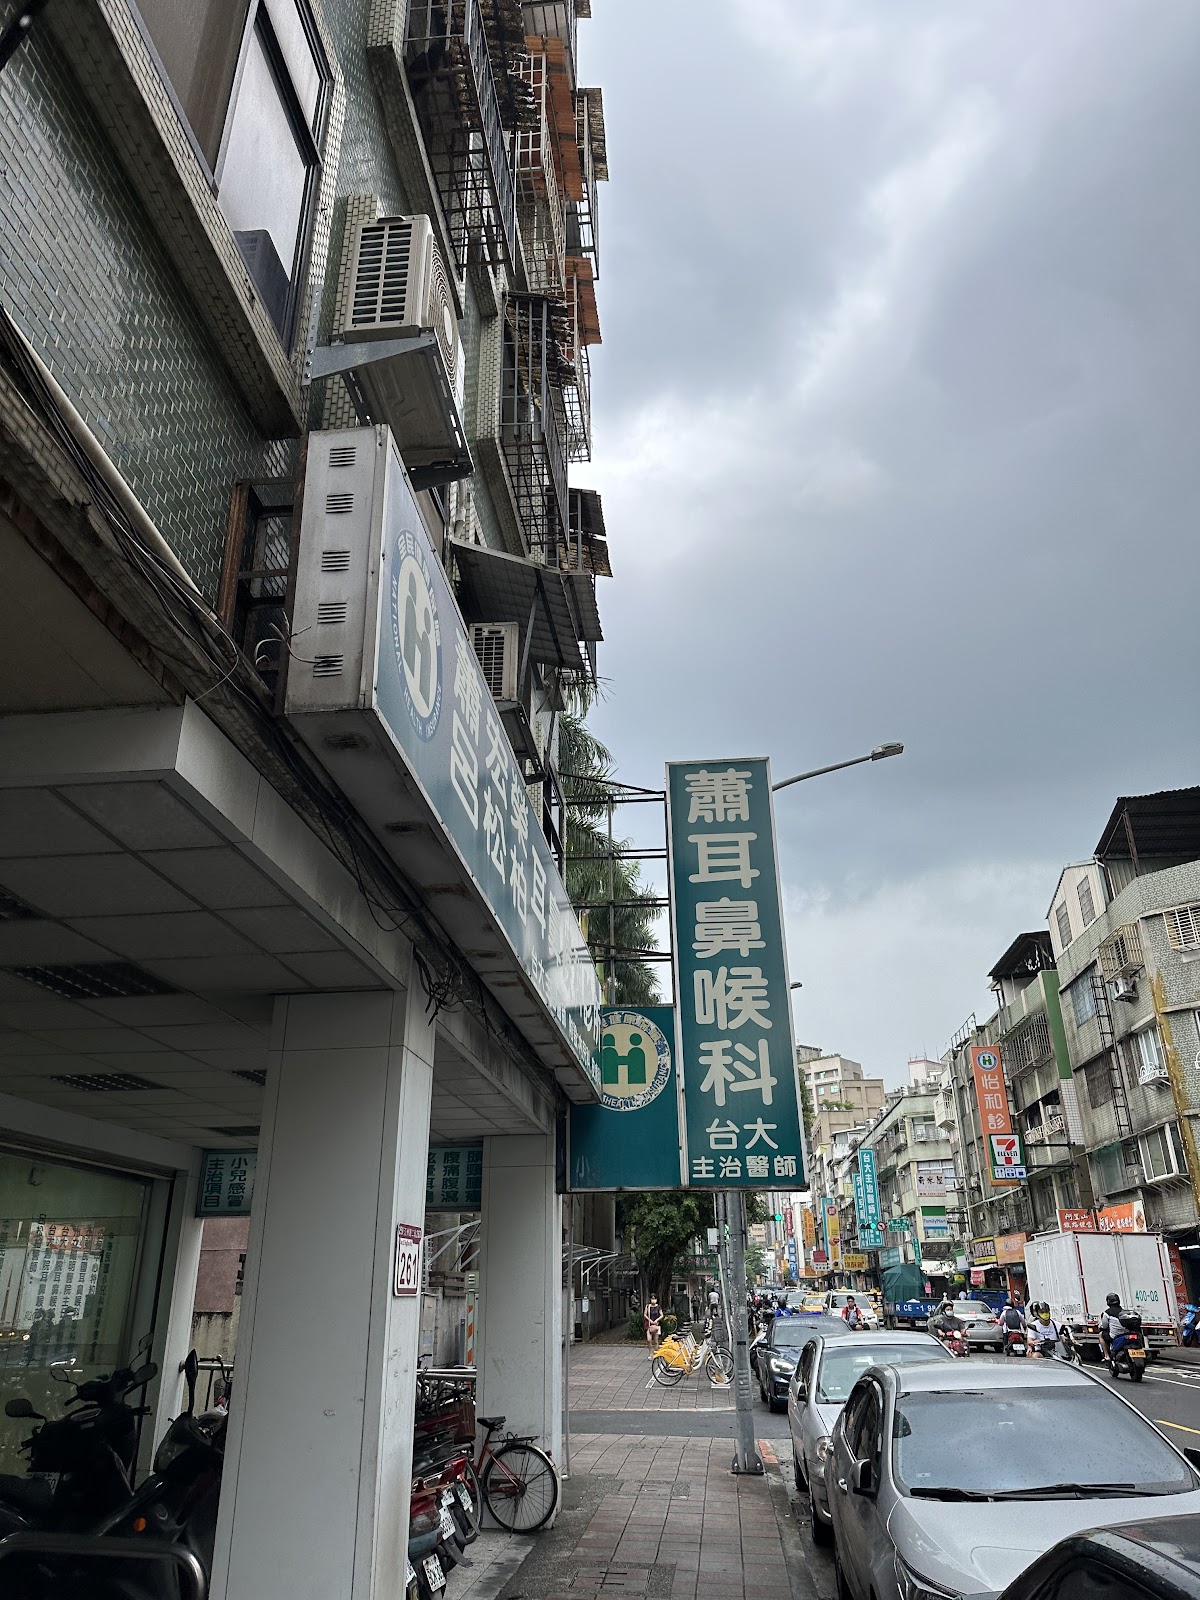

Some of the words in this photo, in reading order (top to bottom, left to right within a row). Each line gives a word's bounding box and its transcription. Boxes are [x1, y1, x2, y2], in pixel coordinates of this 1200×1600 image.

[392, 575, 404, 674] NATIONAL
[403, 689, 423, 736] HEALTH
[454, 628, 528, 859] 蕭宏榮
[450, 710, 528, 927] 呂松柏
[685, 768, 778, 1107] 蕭耳鼻喉科
[981, 1074, 1006, 1130] 怡和診
[705, 1117, 779, 1150] 台大
[204, 1157, 225, 1207] 主治項目
[441, 1151, 461, 1203] 腹痛腹瀉
[692, 1154, 797, 1179] 主治醫師
[863, 1153, 876, 1214] 台大主治醫師
[923, 1217, 946, 1226] FamilyMart
[400, 1252, 417, 1285] 261
